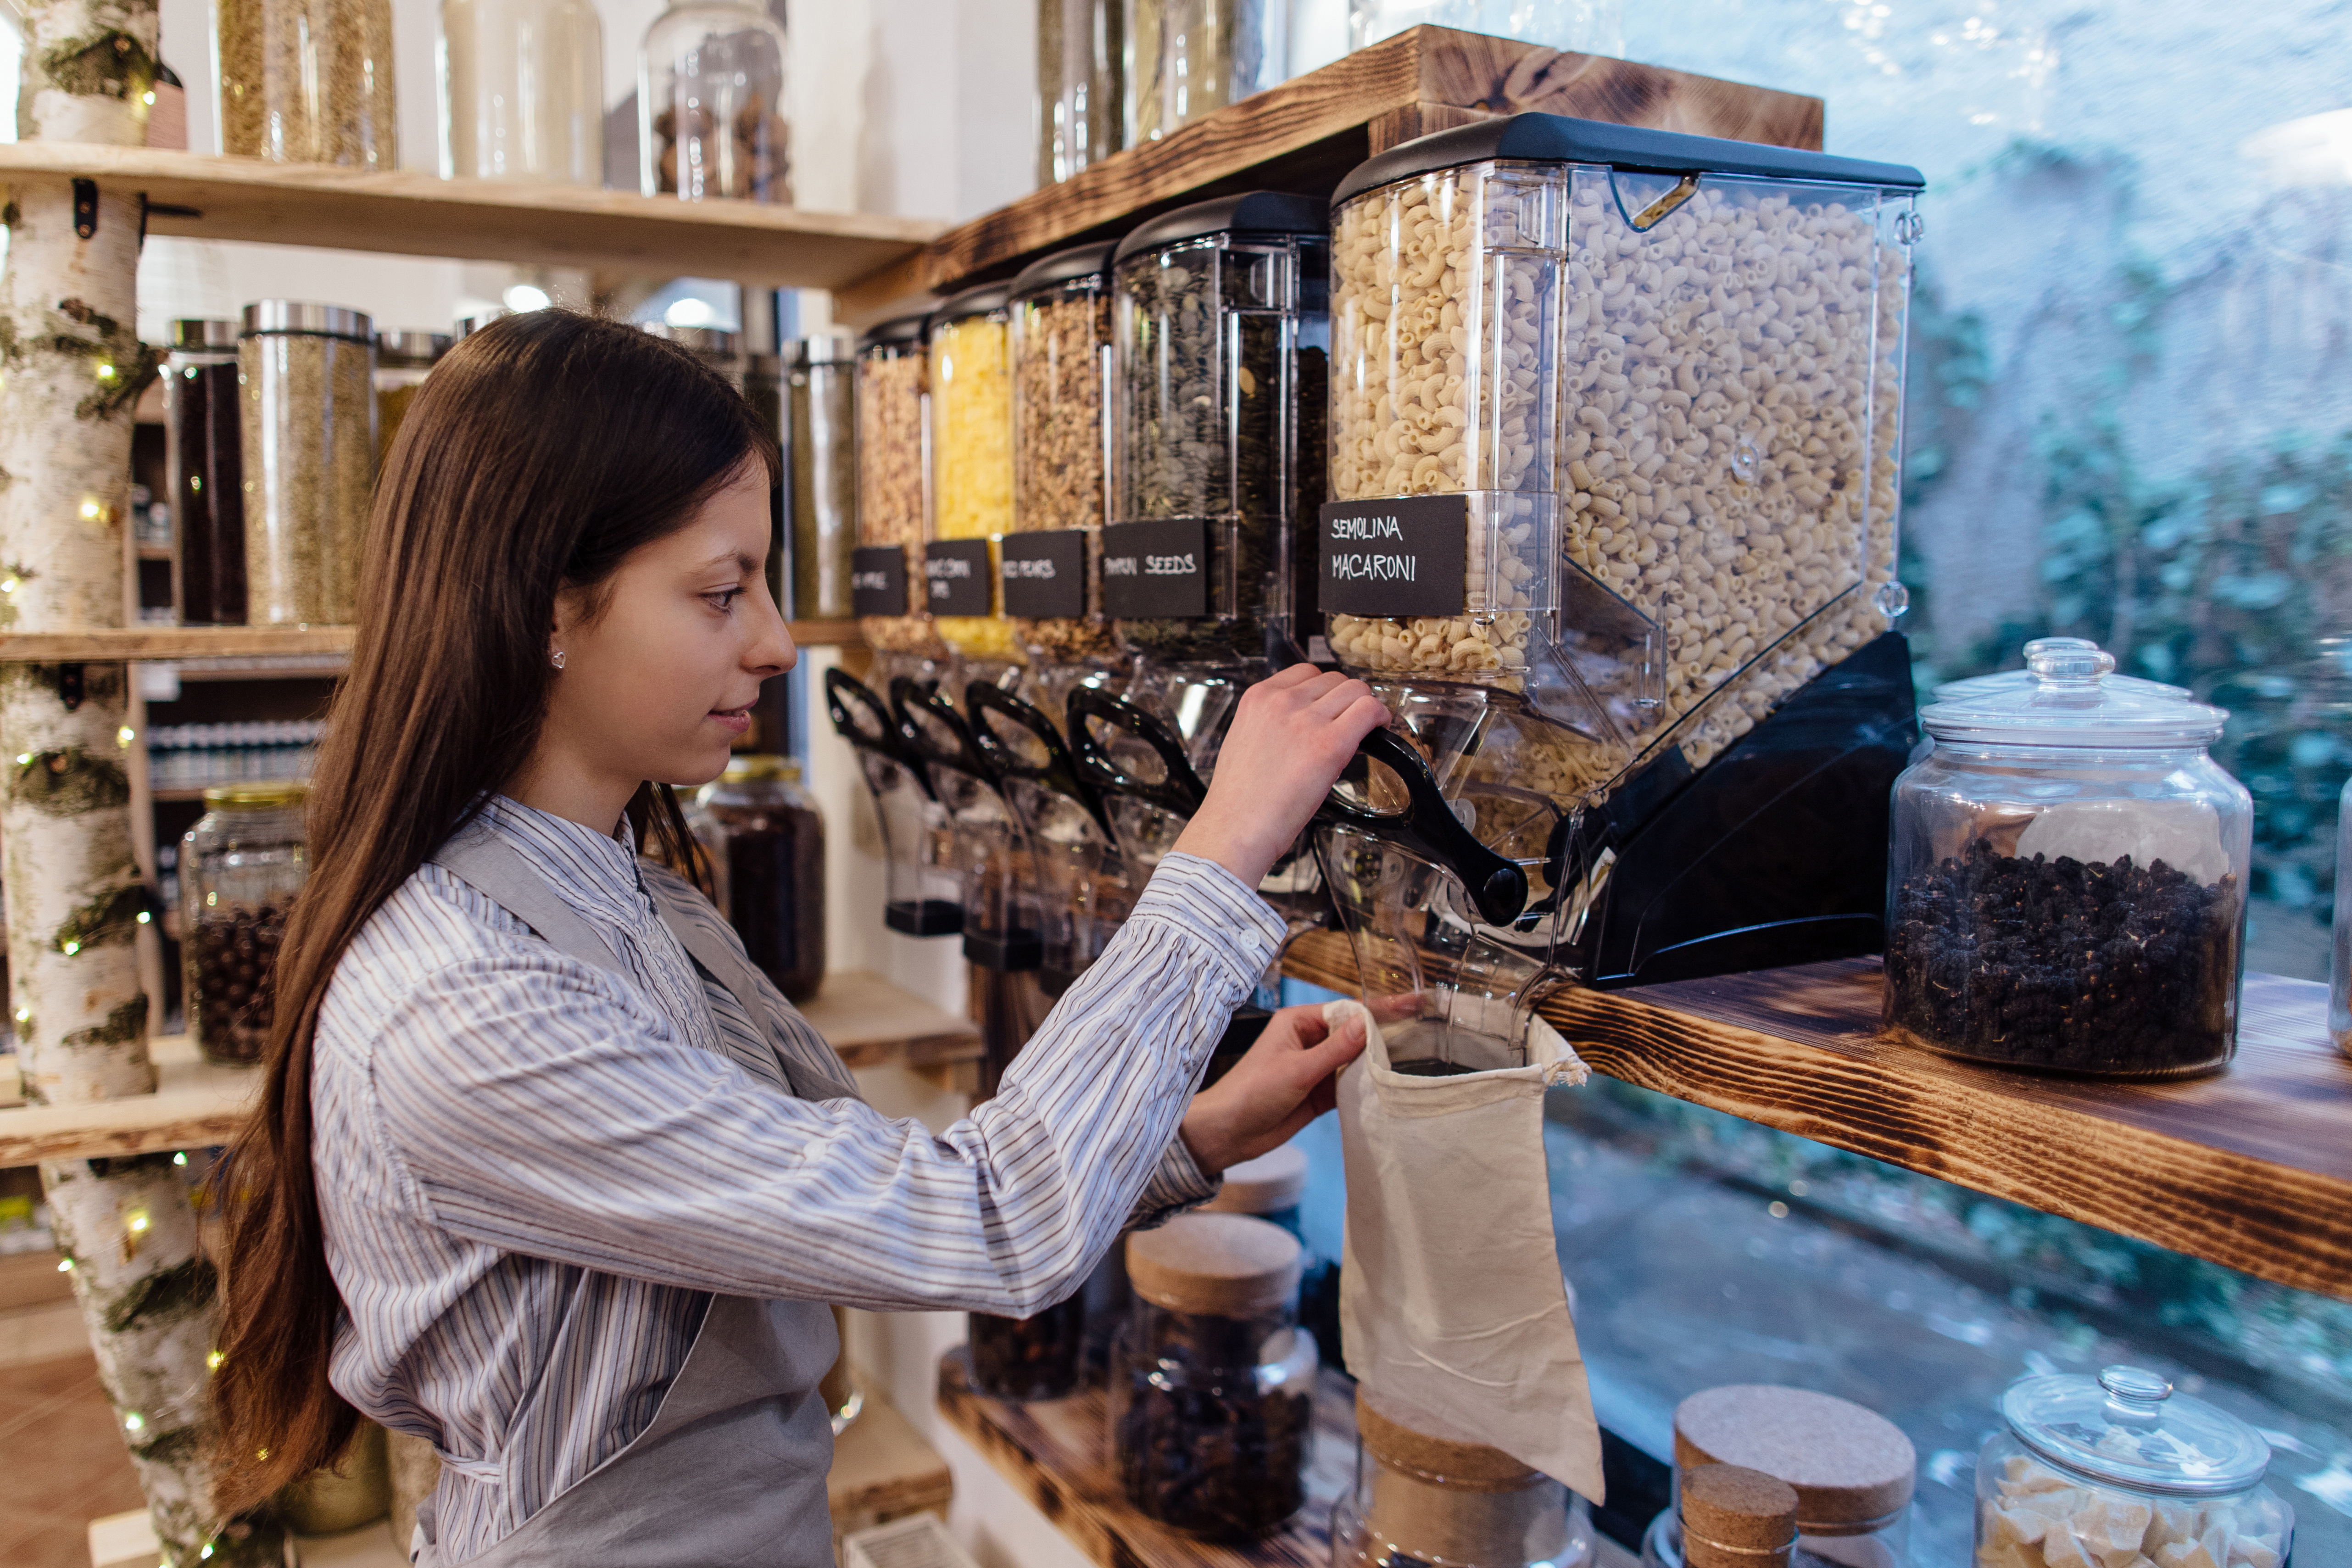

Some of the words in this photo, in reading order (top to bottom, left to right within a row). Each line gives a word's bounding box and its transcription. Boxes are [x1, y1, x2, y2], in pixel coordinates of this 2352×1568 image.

[1331, 515, 1403, 541] SEMOLINA
[1145, 553, 1197, 575] SEEDS
[1332, 553, 1416, 582] MACARONI
